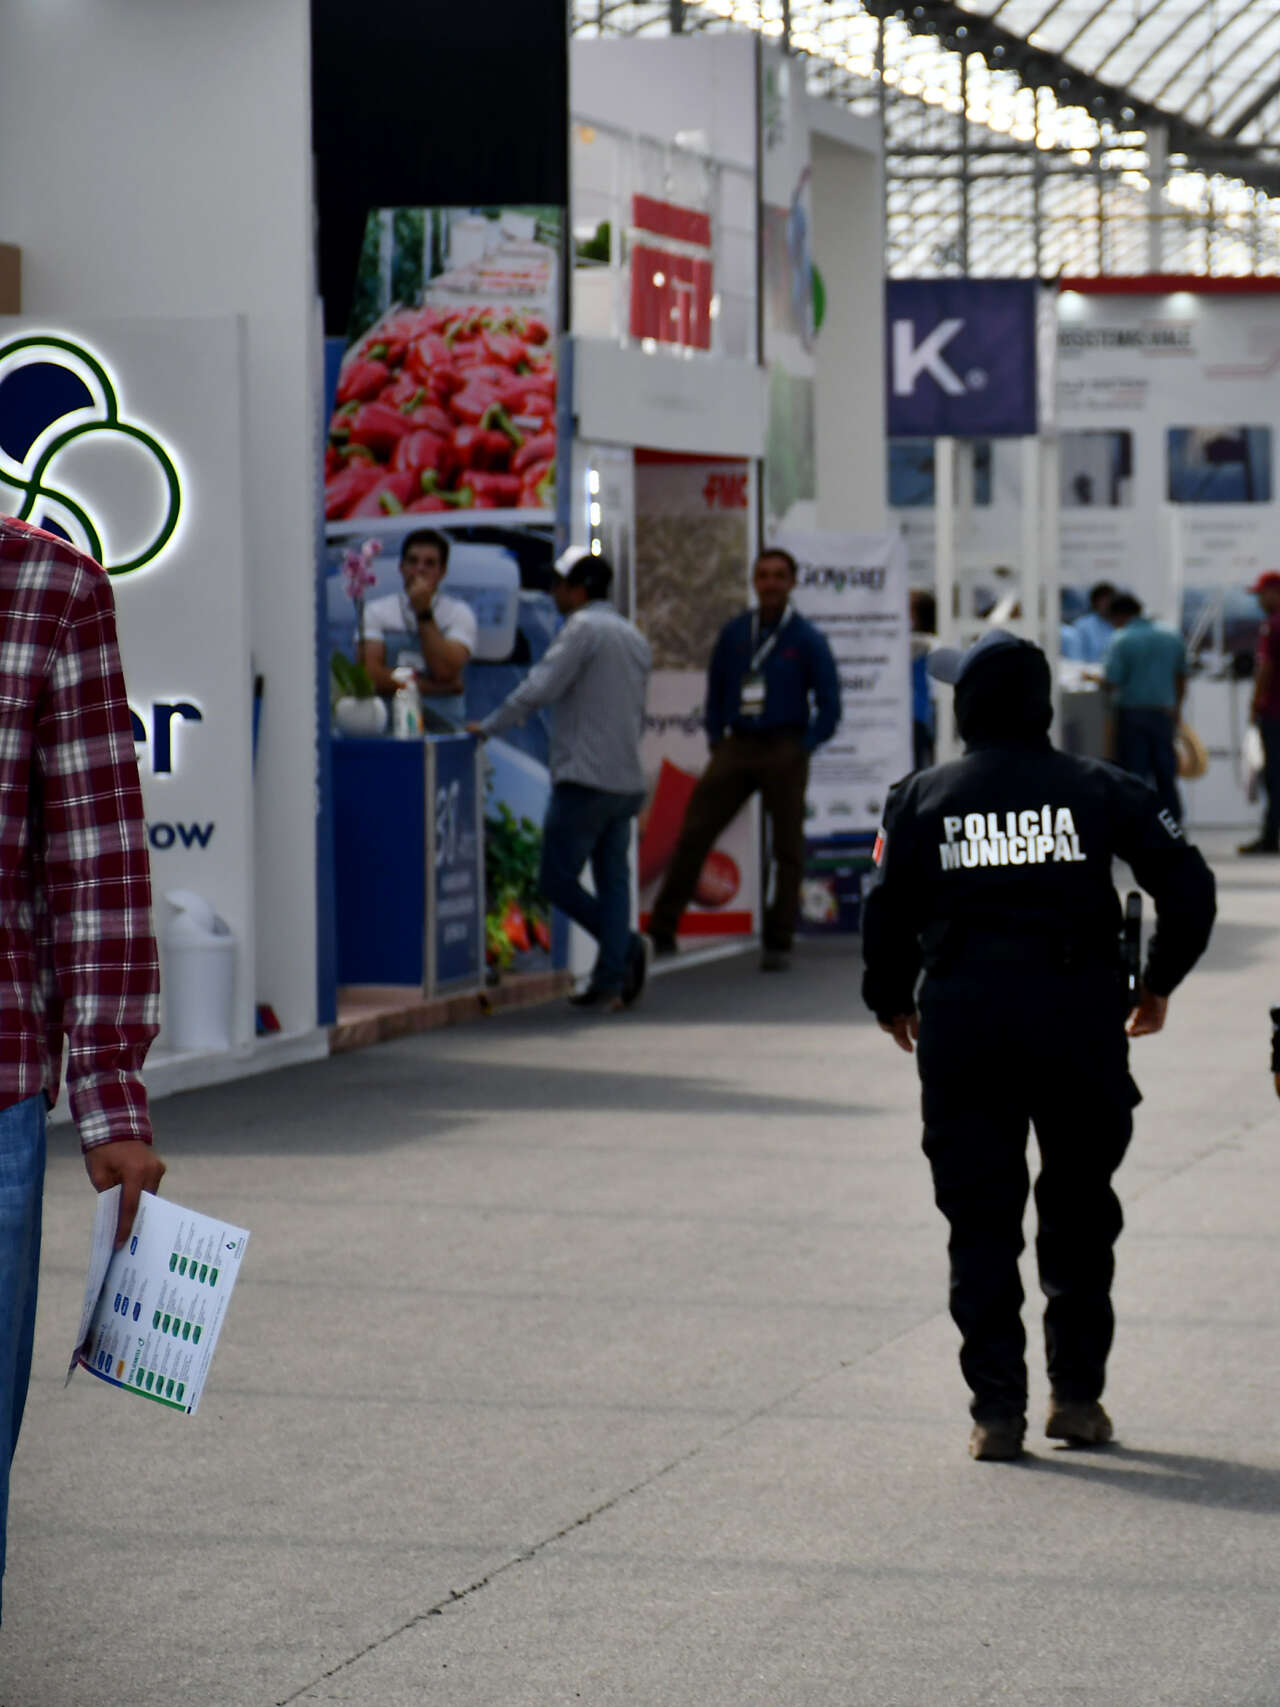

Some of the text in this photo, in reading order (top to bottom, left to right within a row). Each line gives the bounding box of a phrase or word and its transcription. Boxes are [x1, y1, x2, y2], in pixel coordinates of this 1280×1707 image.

[146, 821, 215, 850] ow
[943, 804, 1077, 842] POLICÍA
[938, 834, 1087, 871] MUNICIPAL
